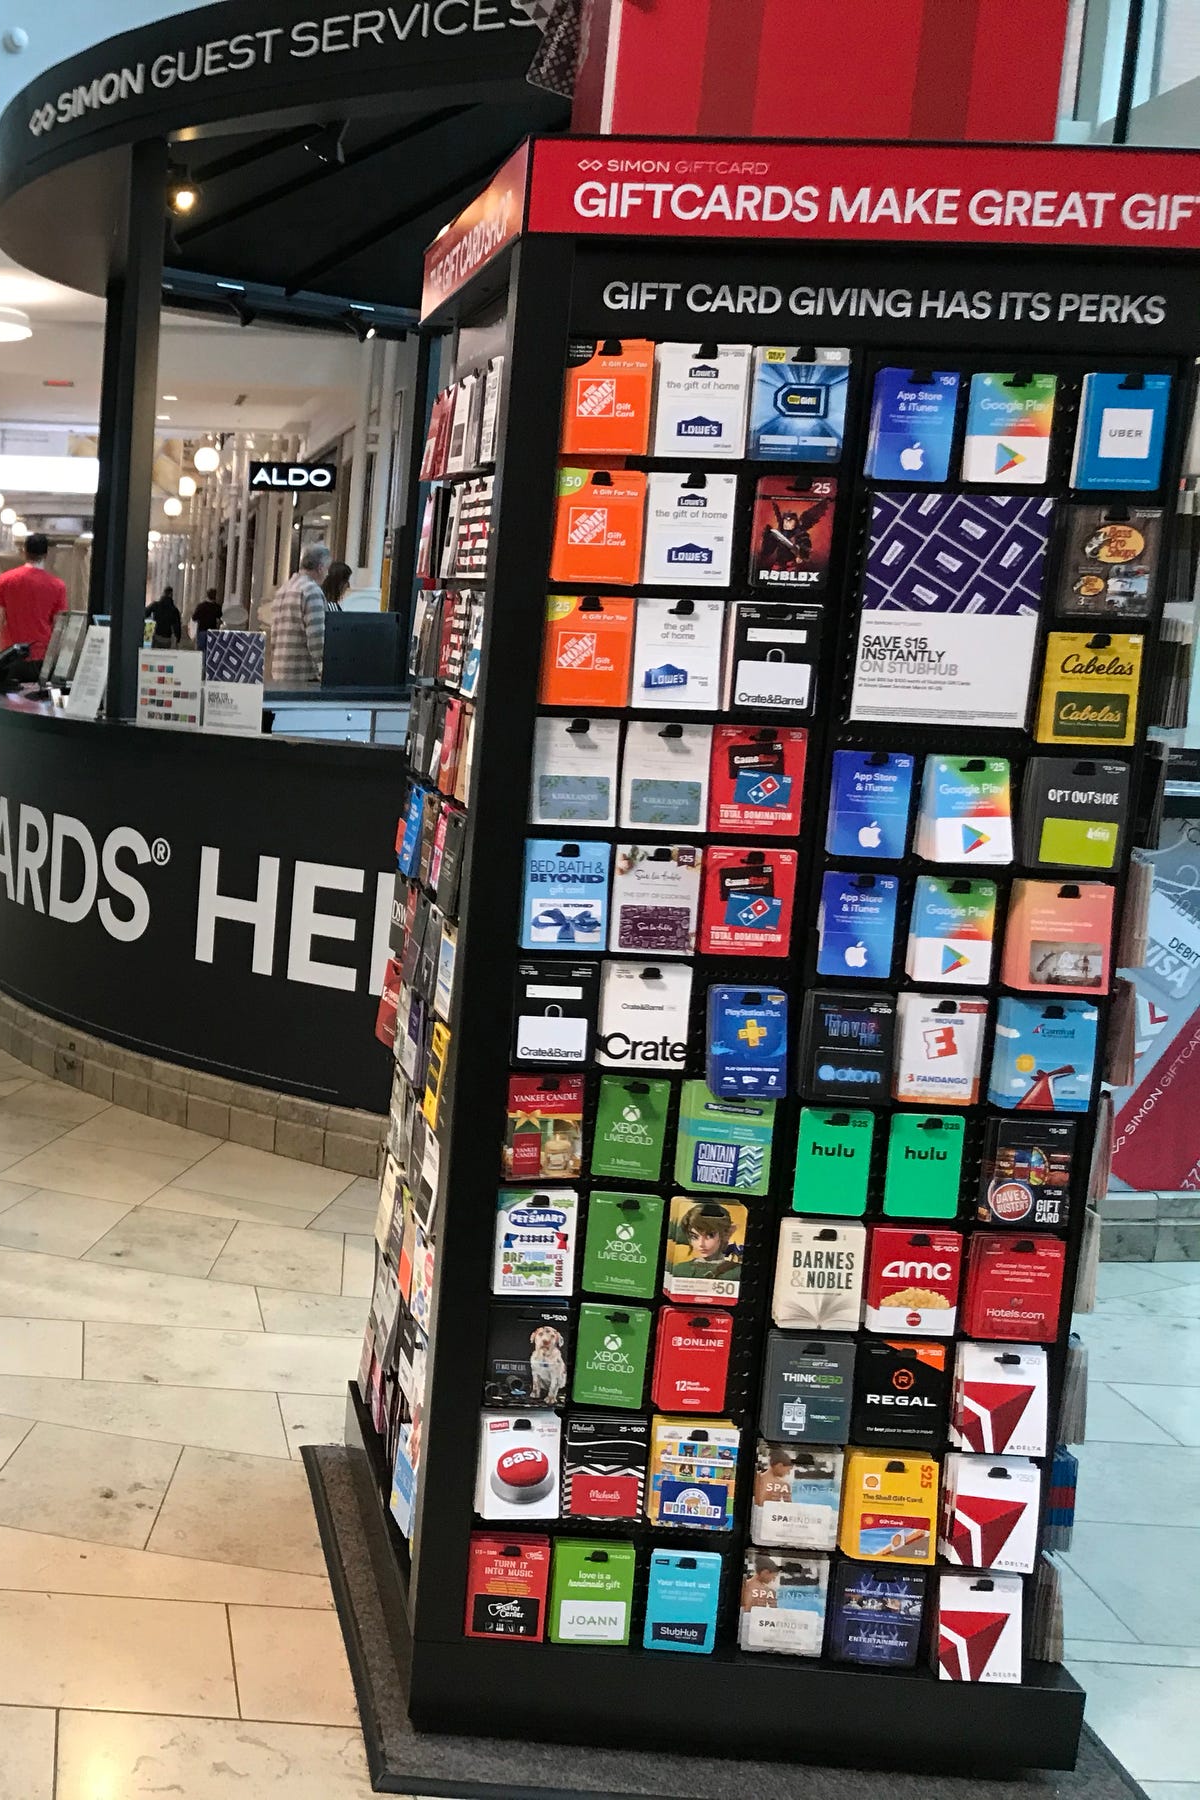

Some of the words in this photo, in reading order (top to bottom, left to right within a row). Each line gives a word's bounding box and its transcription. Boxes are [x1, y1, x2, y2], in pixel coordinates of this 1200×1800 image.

[56, 63, 145, 125] SIMON
[150, 27, 285, 90] GUEST
[607, 159, 671, 173] SIMON
[675, 161, 770, 176] GIFTCARD
[573, 181, 820, 224] GIFTCARDS
[828, 185, 959, 227] MAKE
[967, 187, 1116, 230] GREAT
[603, 280, 679, 312] GIFT
[685, 283, 782, 314] CARD
[789, 286, 912, 319] GIVING
[920, 290, 992, 320] HAS
[999, 292, 1049, 321] ITS
[1058, 294, 1166, 325] PERKS
[690, 369, 718, 378] LOWE'S
[666, 380, 682, 391] the
[683, 380, 703, 392] gift
[704, 381, 714, 391] of
[715, 382, 740, 391] home
[940, 376, 956, 387] $50
[577, 380, 615, 416] HOME
[897, 390, 916, 402] App
[918, 391, 943, 401] Store
[616, 403, 632, 411] Gift
[899, 402, 907, 411] &
[908, 402, 939, 413] iTunes
[981, 398, 1022, 413] Google
[1024, 398, 1052, 413] Play
[681, 423, 719, 436] LOWE'S
[1108, 428, 1143, 438] UBER
[252, 468, 332, 488] ALDO
[811, 482, 831, 494] $25
[679, 498, 706, 507] LOWE'S
[655, 509, 671, 518] the
[672, 509, 692, 520] gift
[693, 510, 703, 519] of
[704, 511, 728, 520] home
[568, 509, 607, 544] HOME
[607, 531, 623, 540] Gift
[671, 550, 709, 563] LOWE'S
[759, 570, 820, 583] ROBLOX
[663, 623, 678, 631] the
[679, 623, 694, 633] gift
[660, 631, 670, 640] of
[671, 631, 696, 640] home
[862, 635, 902, 649] SAVE
[904, 637, 928, 650] $15
[558, 634, 596, 667] HOME
[861, 648, 946, 663] INSTANTLY
[595, 656, 610, 665] Gift
[1060, 653, 1134, 677] Cabela's
[595, 663, 614, 672] Card
[860, 660, 884, 673] ON
[887, 661, 960, 676] STUBHUB
[651, 673, 685, 685] LOWE'S
[738, 691, 805, 706] Crate&Barrel
[1059, 702, 1122, 723] Cabela's
[895, 759, 910, 768] $25
[990, 761, 1005, 772] $25
[854, 772, 873, 783] App
[875, 772, 898, 783] Store
[855, 783, 863, 792] &
[864, 783, 894, 793] iTunes
[939, 783, 980, 798] Google
[981, 783, 1005, 798] Play
[720, 810, 742, 819] TOTAL
[744, 811, 793, 821] DOMINATION
[678, 855, 694, 863] $25
[530, 860, 556, 873] BED
[558, 861, 593, 874] BATH
[594, 862, 604, 874] &
[530, 873, 605, 884] BEYOND
[880, 880, 894, 890] $15
[839, 892, 858, 904] App
[859, 893, 884, 903] Store
[979, 887, 994, 897] $25
[841, 904, 849, 914] &
[850, 904, 880, 915] iTunes
[926, 903, 966, 918] Google
[968, 904, 989, 919] Play
[710, 931, 733, 941] TOTAL
[734, 932, 782, 942] DOMINATION
[1169, 937, 1200, 964] DEBIT
[621, 1003, 665, 1011] Crate&Barrel
[725, 1008, 765, 1018] PlayStation
[766, 1009, 781, 1018] Plus
[1041, 1027, 1076, 1037] Carnival
[520, 1047, 583, 1059] Crate&Barrel
[602, 1032, 687, 1062] Crate
[916, 1075, 968, 1084] FANDANGO
[513, 1093, 545, 1103] YANKEE
[546, 1092, 578, 1101] CANDLE
[1124, 1088, 1163, 1136] SIMON
[612, 1121, 649, 1135] XBOX
[852, 1119, 868, 1128] $25
[603, 1133, 624, 1142] LIVE
[625, 1134, 654, 1146] GOLD
[698, 1143, 737, 1163] CONTAIN
[811, 1141, 855, 1158] hulu
[904, 1145, 948, 1161] hulu
[696, 1164, 734, 1185] YOURSELF
[1036, 1199, 1061, 1213] GIFT
[510, 1213, 565, 1224] PETSMART
[1034, 1212, 1060, 1224] CARD
[605, 1240, 642, 1254] XBOX
[597, 1250, 618, 1260] LIVE
[619, 1251, 647, 1264] GOLD
[792, 1250, 855, 1270] BARNES
[881, 1261, 953, 1281] amc
[806, 1271, 853, 1290] NOBLE
[711, 1282, 735, 1295] $50
[986, 1307, 1046, 1321] Hotels.com
[683, 1337, 725, 1348] ONLINE
[593, 1350, 630, 1364] XBOX
[586, 1361, 606, 1371] LIVE
[607, 1362, 635, 1374] GOLD
[866, 1394, 937, 1407] REGAL
[502, 1450, 543, 1468] easy
[920, 1465, 932, 1489] $25
[862, 1493, 875, 1501] The
[876, 1494, 891, 1502] Shell
[892, 1495, 905, 1503] Gift
[664, 1502, 721, 1518] WORKSHOP
[494, 1559, 517, 1569] TURN
[519, 1561, 529, 1569] IT
[1005, 1560, 1030, 1569] DELTA
[484, 1567, 505, 1575] INTO
[507, 1568, 534, 1578] MUSIC
[578, 1570, 596, 1579] love
[597, 1571, 604, 1580] is
[605, 1579, 621, 1590] gift
[657, 1579, 674, 1587] Your
[675, 1580, 697, 1588] ticket
[567, 1615, 618, 1627] JOANN
[660, 1626, 698, 1637] StubHub
[848, 1635, 909, 1648] ENTERTAINMENT
[992, 1671, 1018, 1679] DELTA
